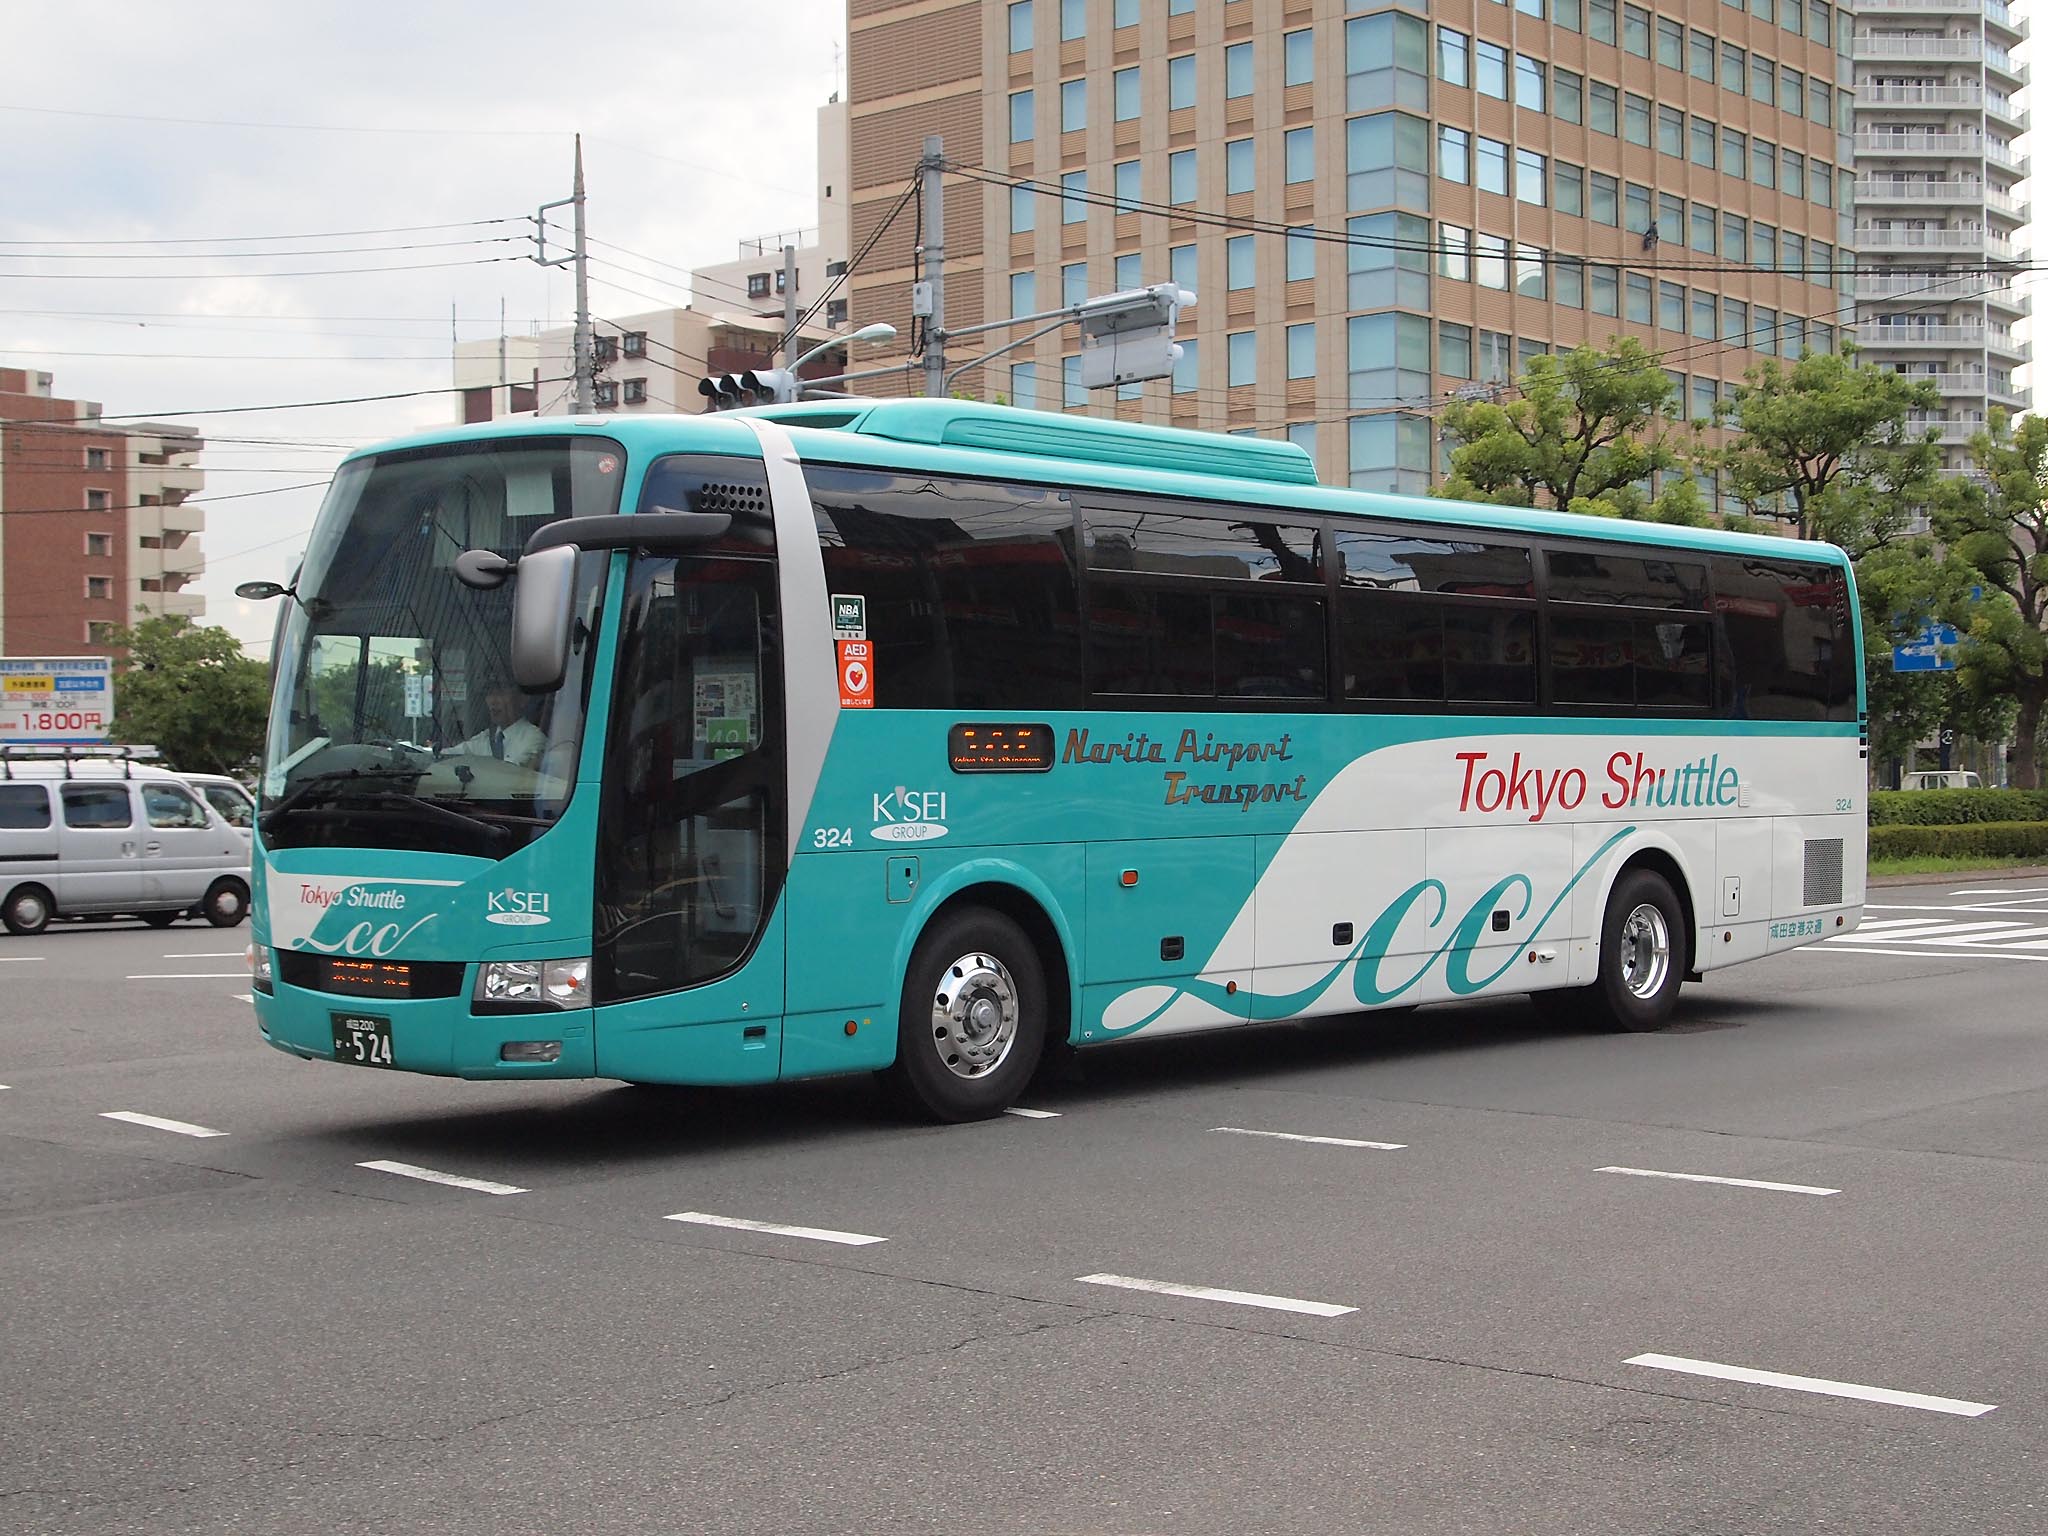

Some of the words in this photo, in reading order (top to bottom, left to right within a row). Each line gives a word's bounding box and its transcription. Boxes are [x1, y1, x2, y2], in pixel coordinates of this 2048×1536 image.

[839, 604, 859, 616] NBA
[844, 644, 867, 656] AED
[1062, 728, 1166, 764] Narita
[1174, 728, 1293, 771] Airport
[1164, 771, 1307, 812] Transport
[1455, 752, 1586, 822] Tokyo
[1602, 751, 1738, 809] Shuttle
[1835, 799, 1852, 811] 324
[813, 828, 853, 848] 324
[892, 826, 927, 838] GROUP
[300, 884, 342, 908] Tokyo
[347, 886, 405, 910] Shuttle
[502, 915, 531, 924] GROUP
[1770, 919, 1823, 939] 成田空港交通
